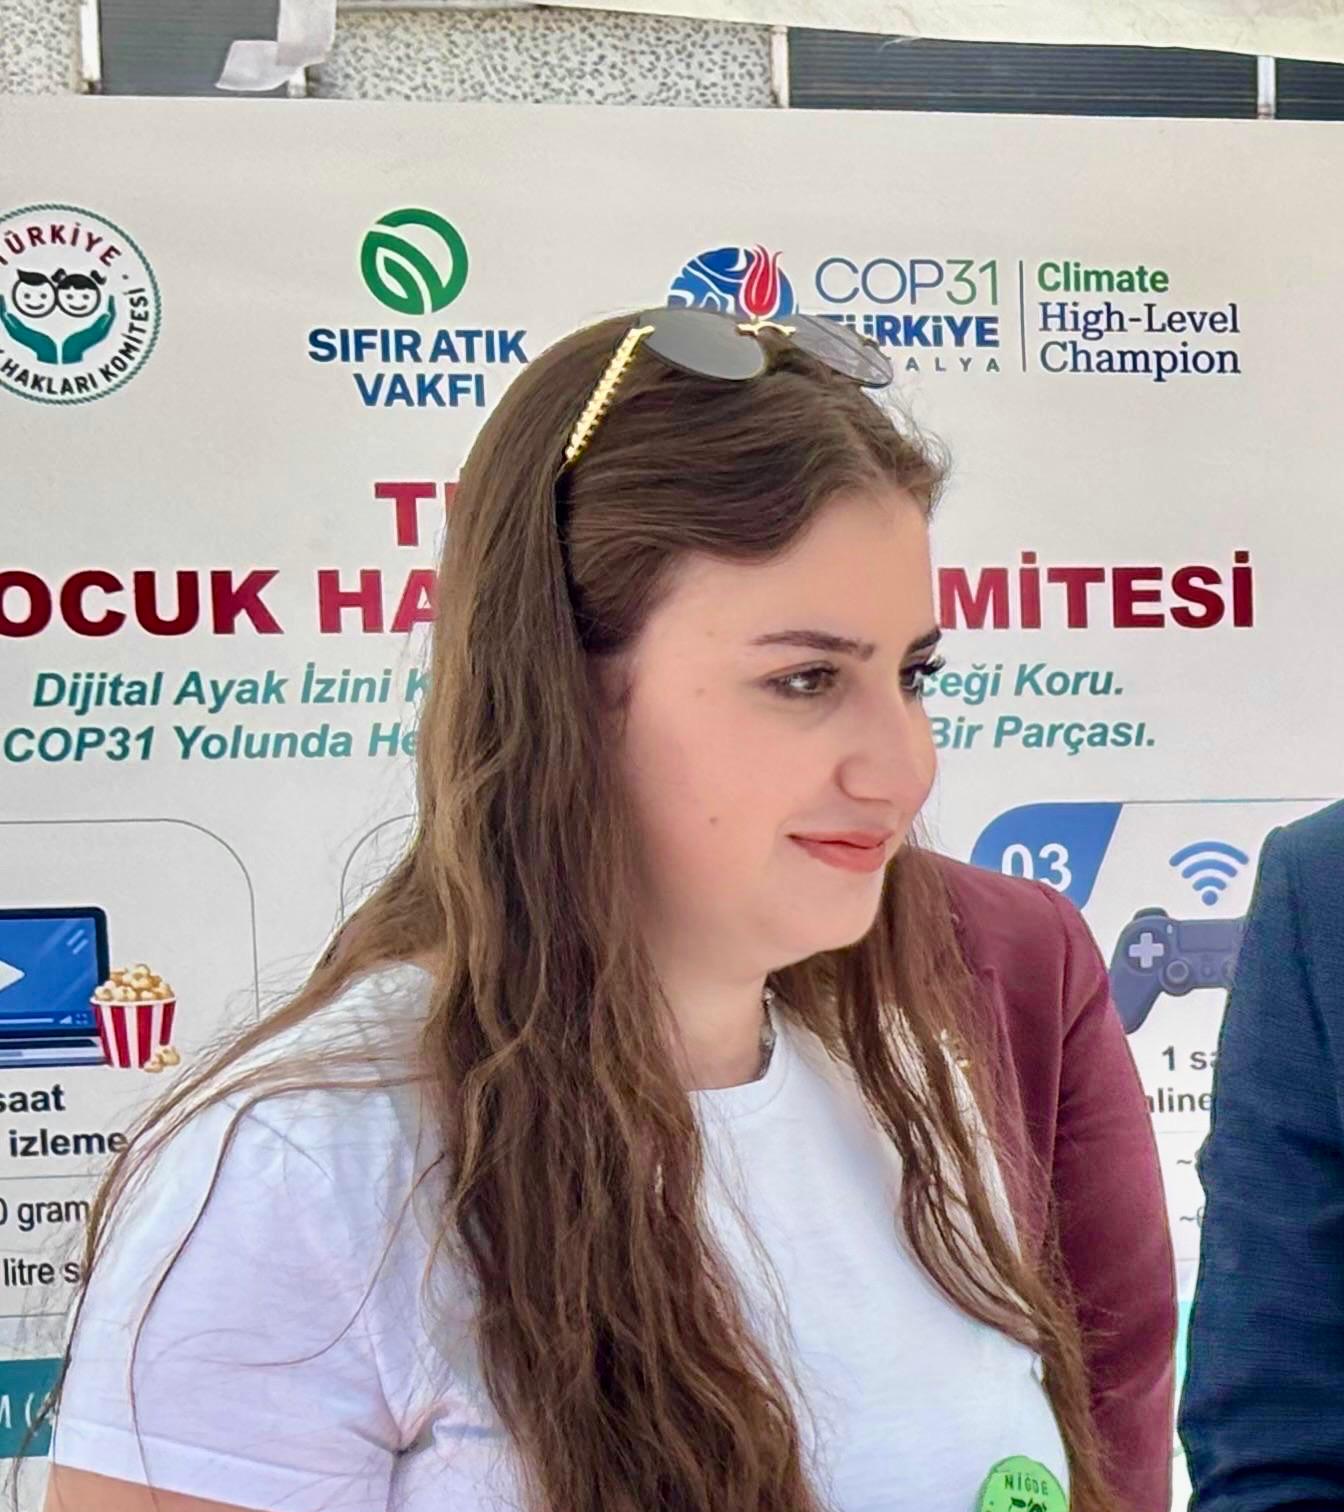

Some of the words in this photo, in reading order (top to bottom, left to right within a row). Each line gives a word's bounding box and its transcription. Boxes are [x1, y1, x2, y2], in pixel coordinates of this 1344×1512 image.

[815, 257, 1000, 305] COP31
[1037, 260, 1169, 293] Climate
[1039, 303, 1240, 337] High-Level
[0, 358, 98, 396] HAKLARI
[98, 287, 149, 383] KOMİTESİ
[308, 328, 422, 362] SIFIR
[428, 329, 529, 363] ATIK
[1040, 340, 1241, 382] Champion
[353, 373, 486, 407] VAKFI
[937, 550, 1256, 630] MİTESİ
[32, 671, 164, 716] Dijital
[173, 671, 288, 713] Ayak
[300, 662, 391, 704] İzini
[1014, 663, 1124, 698] Koru.
[3, 726, 155, 763] COP31
[174, 723, 354, 760] Yolunda
[993, 715, 1156, 756] Parçası.
[1001, 842, 1072, 893] 03
[1161, 1045, 1175, 1071] 1
[8, 1128, 128, 1158] izleme
[17, 1199, 90, 1232] gram
[4, 1257, 55, 1287] litre
